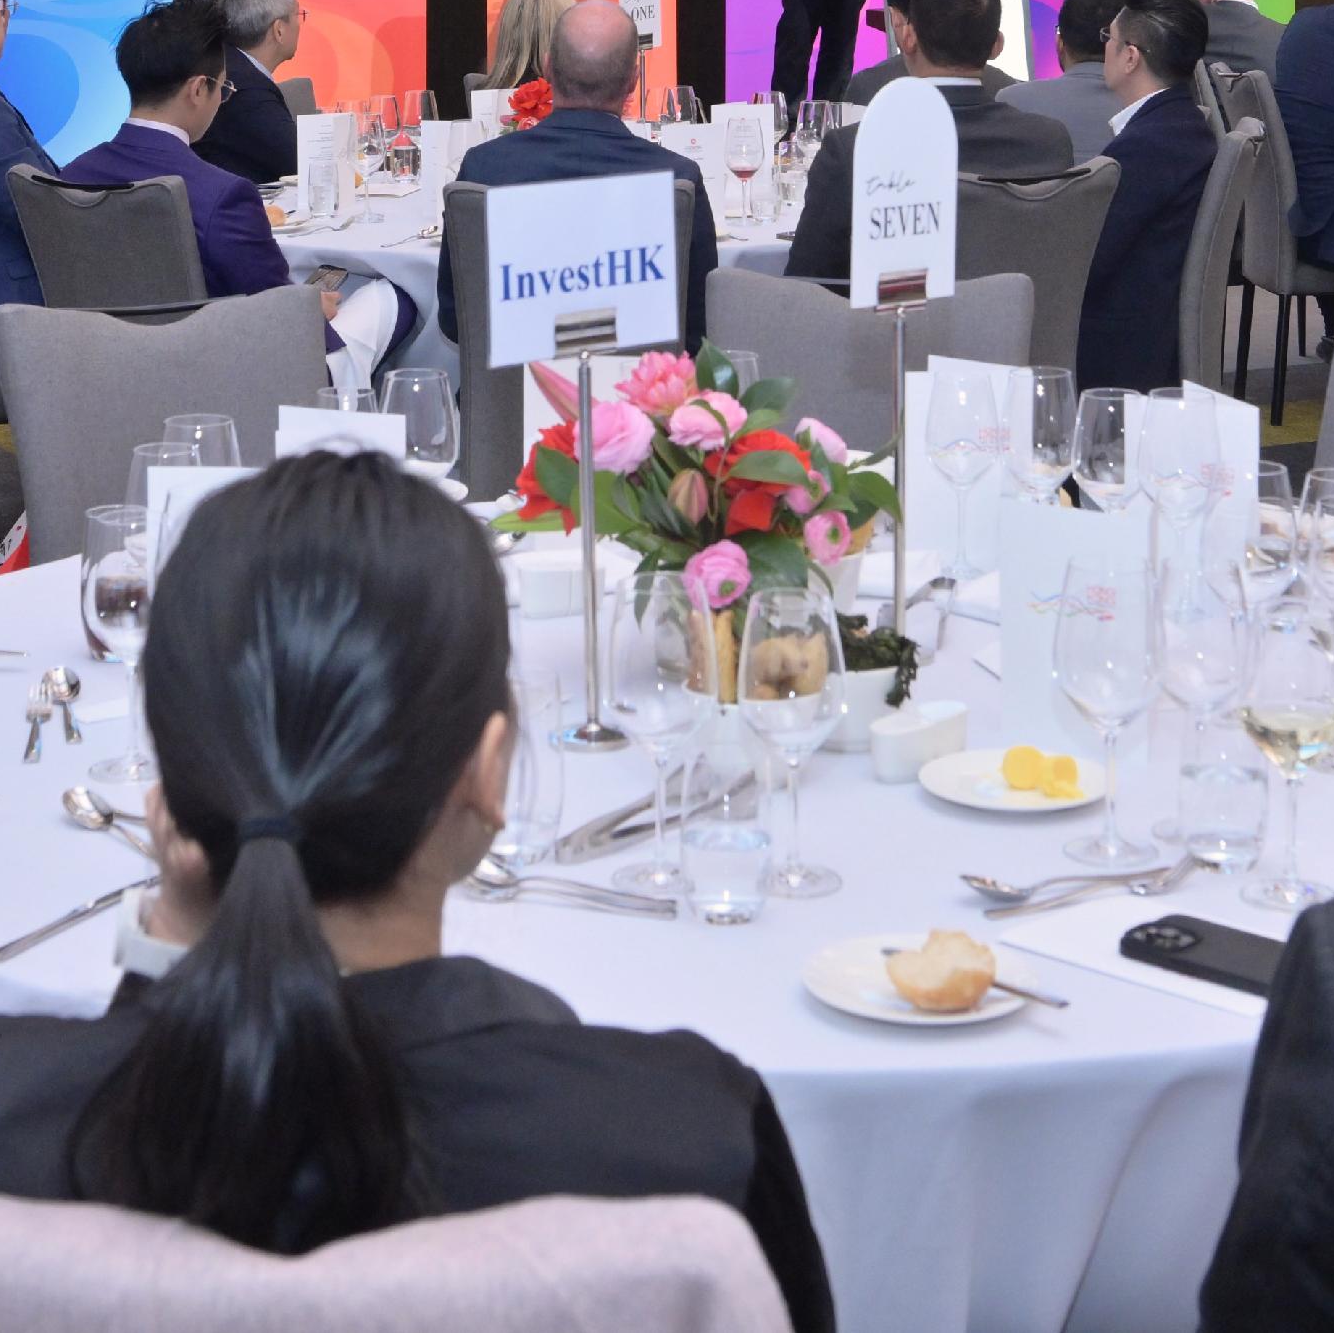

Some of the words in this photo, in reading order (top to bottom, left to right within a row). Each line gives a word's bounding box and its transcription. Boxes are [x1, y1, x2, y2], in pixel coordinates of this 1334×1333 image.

[630, 4, 656, 21] ONE
[869, 201, 941, 241] SEVEN
[499, 243, 667, 303] InvestHK
